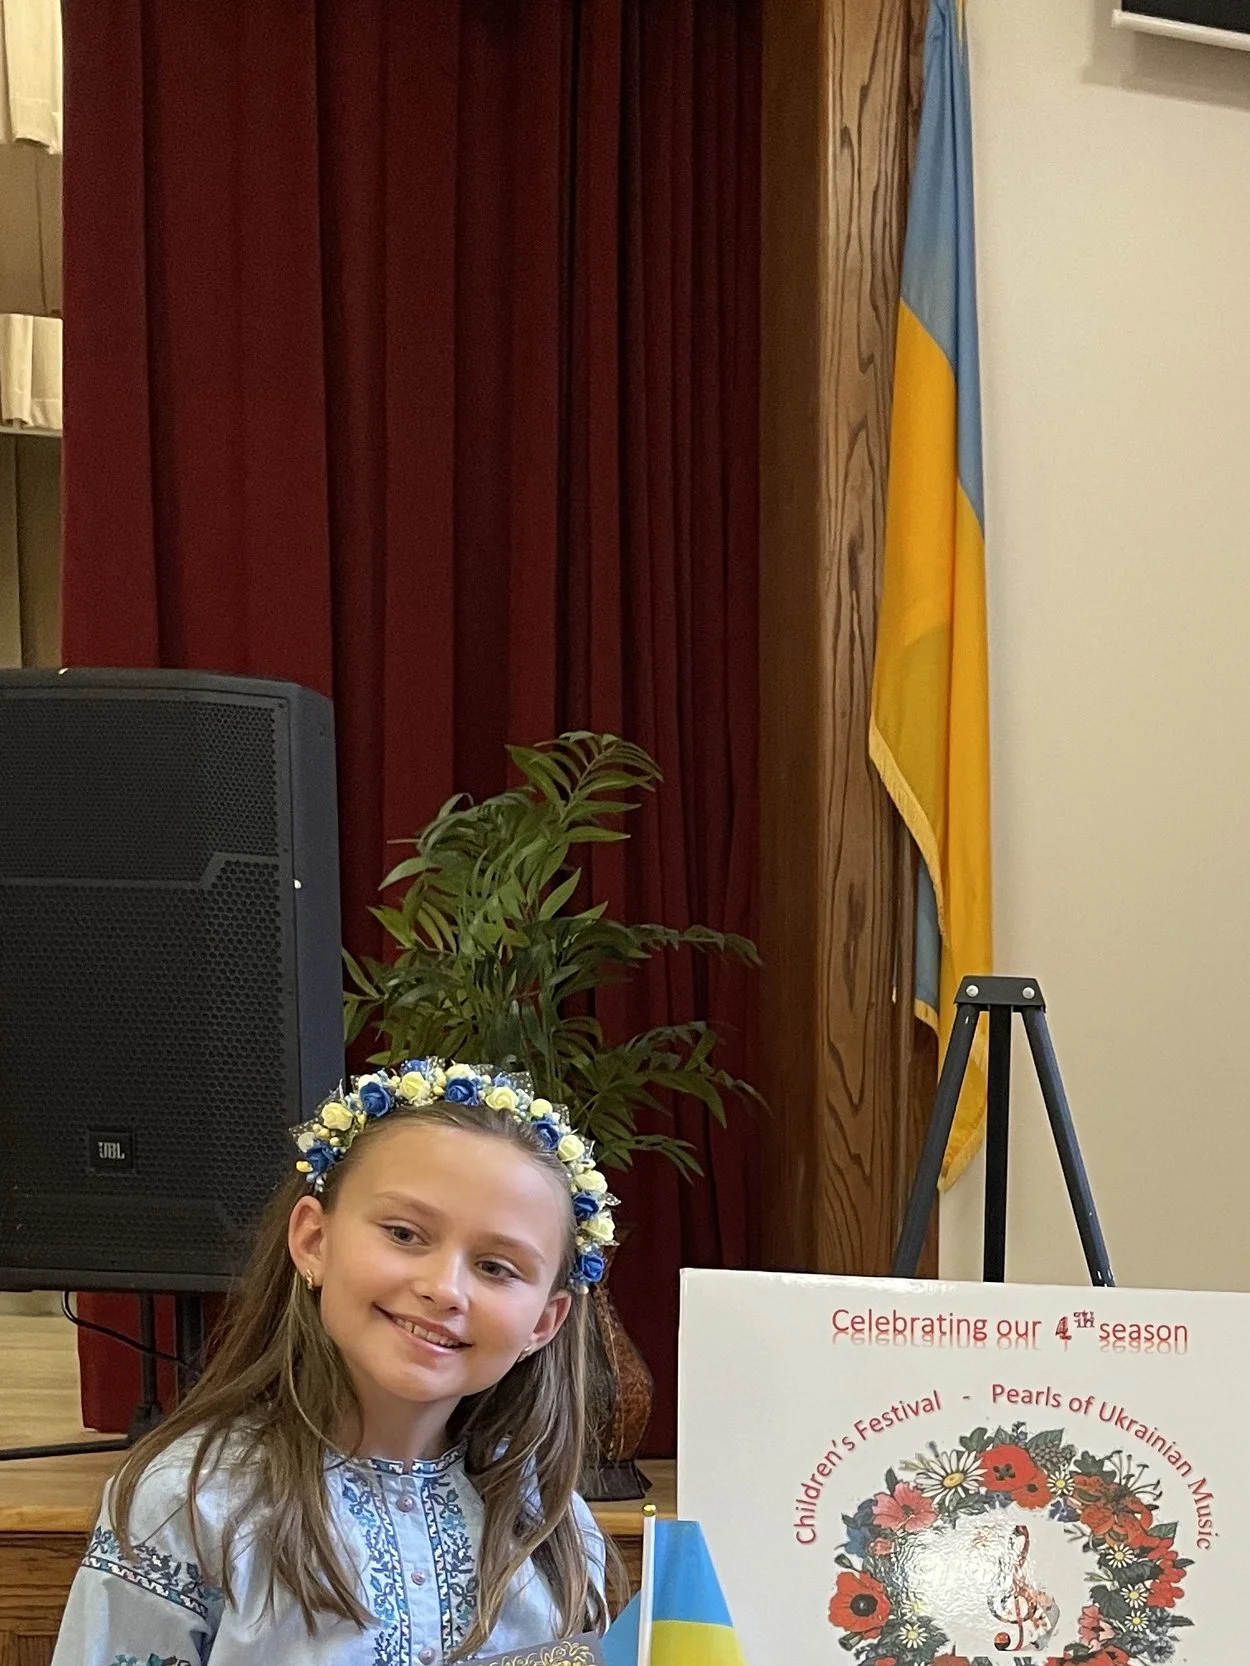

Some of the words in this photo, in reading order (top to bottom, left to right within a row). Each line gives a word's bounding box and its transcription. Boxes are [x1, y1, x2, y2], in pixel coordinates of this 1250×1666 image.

[98, 1141, 125, 1159] JBL
[832, 1308, 988, 1342] Celebrating
[997, 1319, 1042, 1339] our
[1099, 1320, 1188, 1343] season
[854, 1390, 942, 1440] Festival
[992, 1384, 1062, 1408] Pearls
[1069, 1396, 1095, 1415] of
[1099, 1401, 1193, 1477] Ukrainian
[1187, 1477, 1220, 1550] Music
